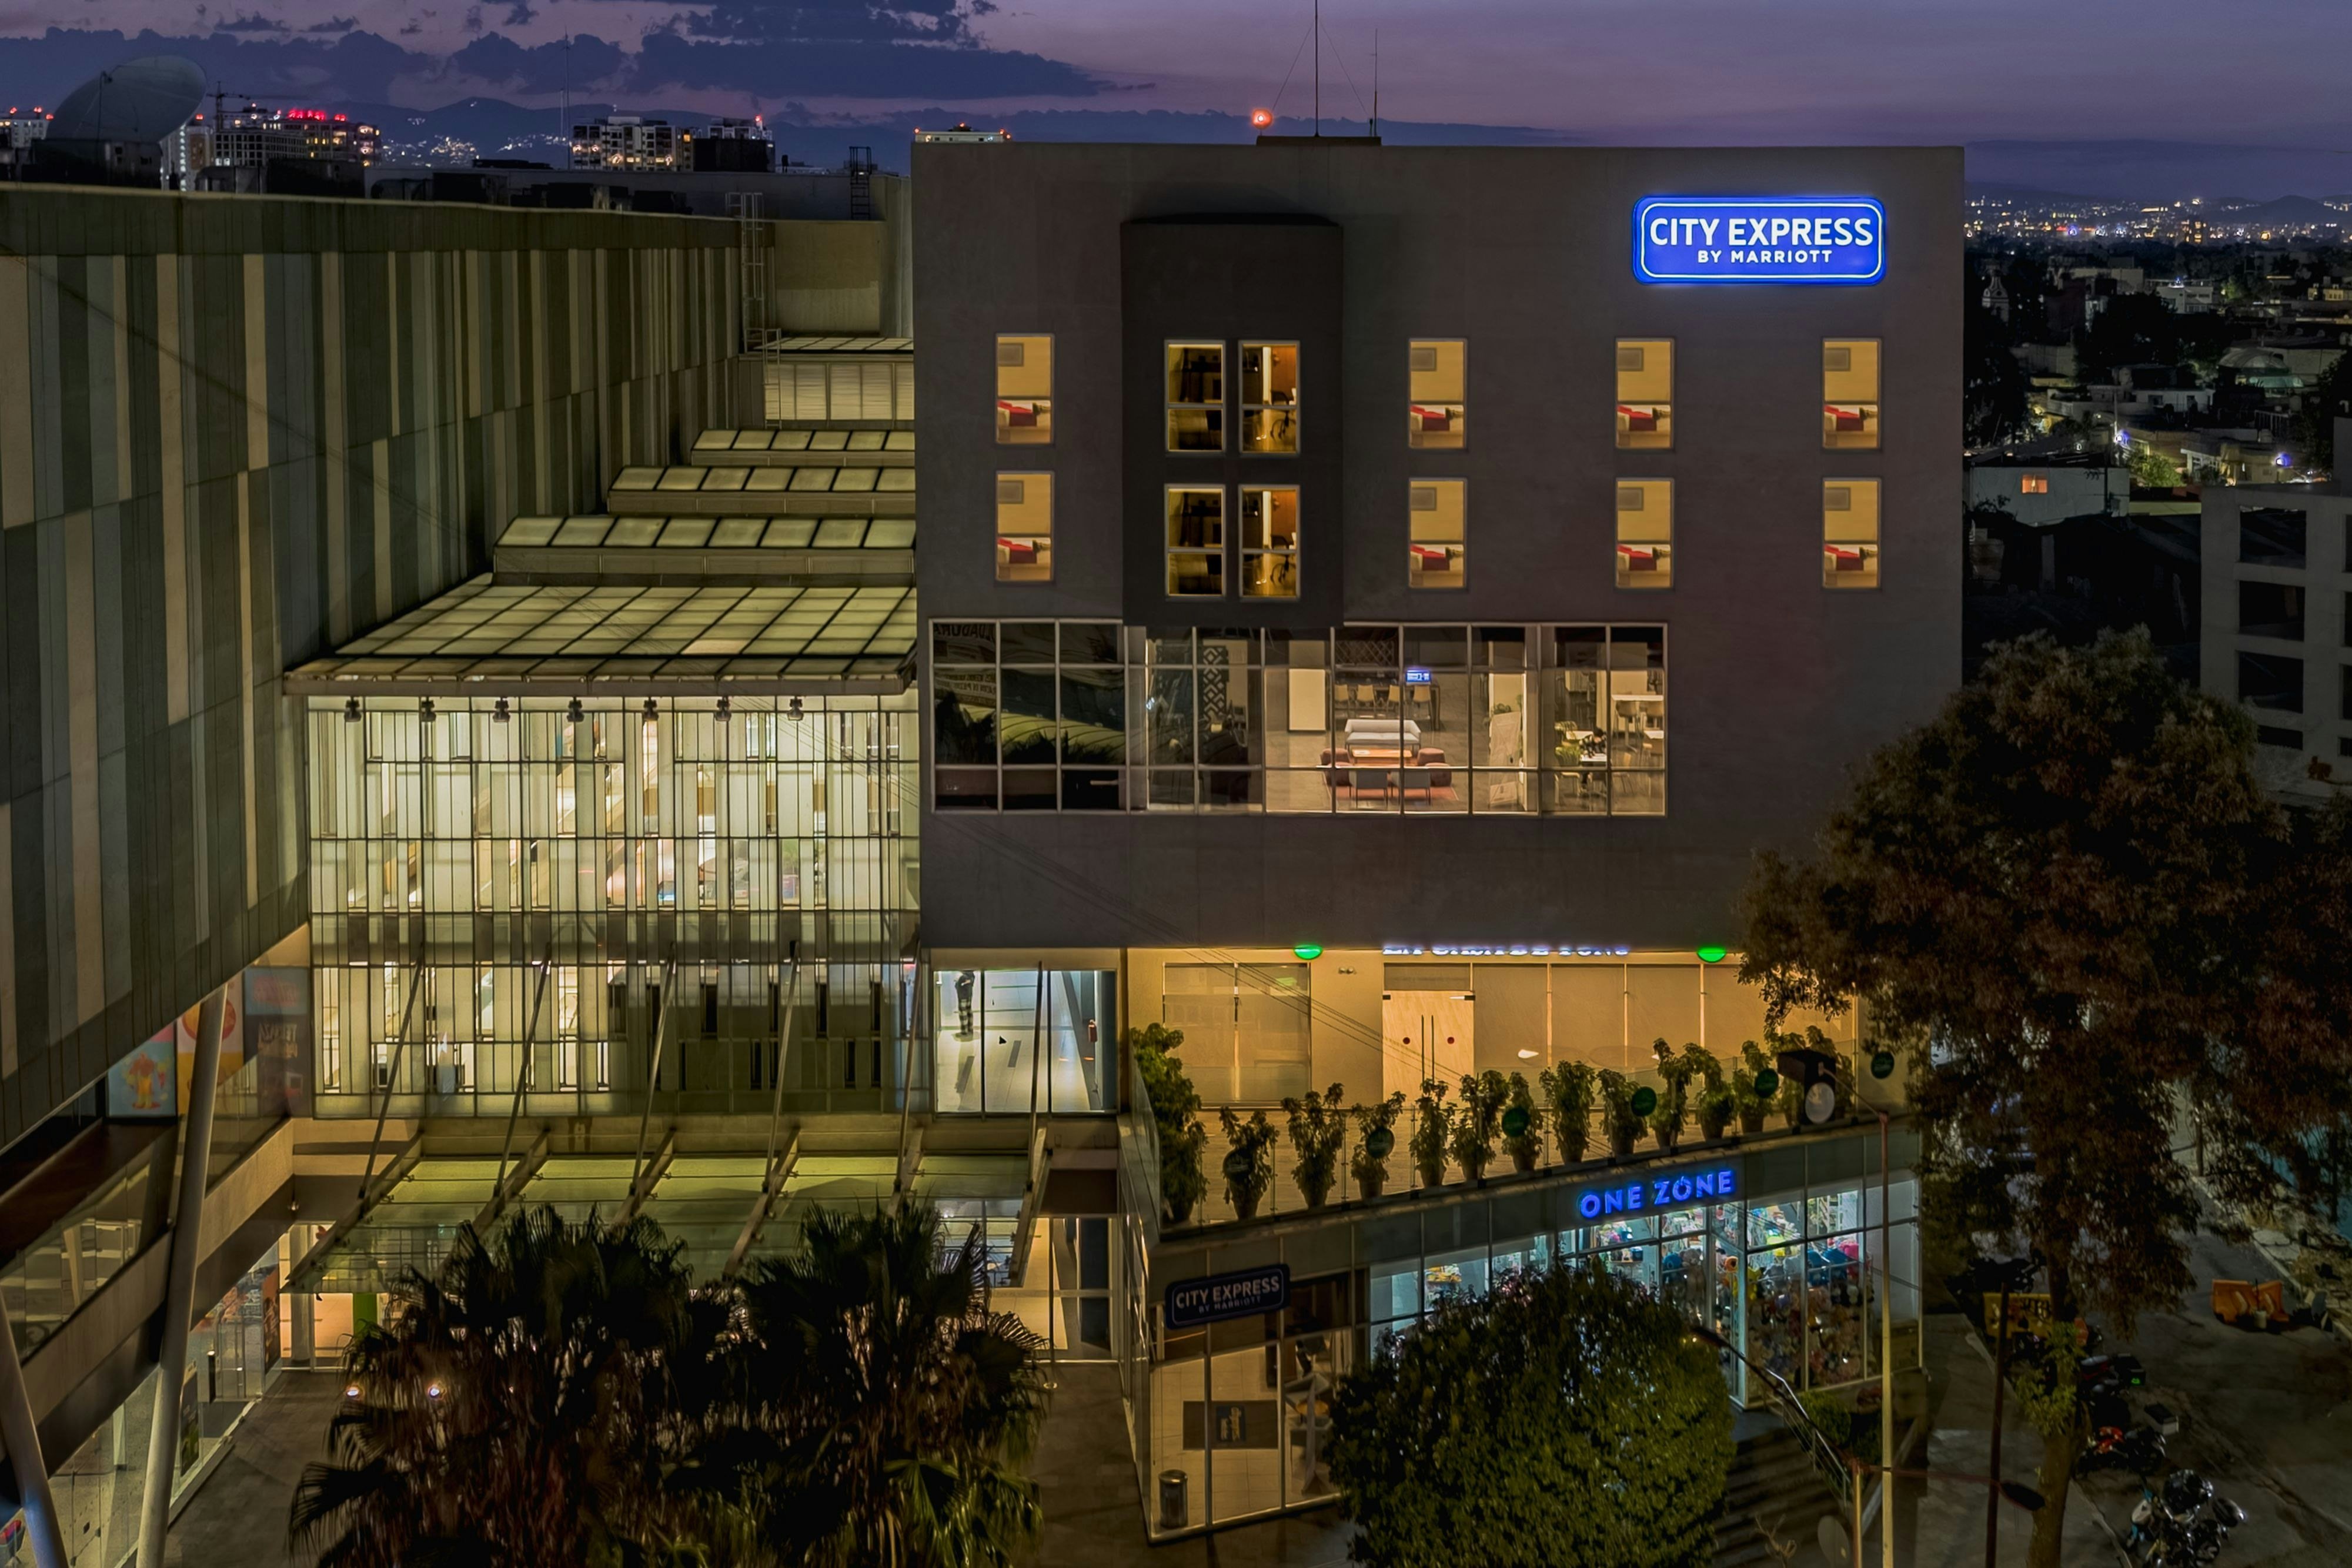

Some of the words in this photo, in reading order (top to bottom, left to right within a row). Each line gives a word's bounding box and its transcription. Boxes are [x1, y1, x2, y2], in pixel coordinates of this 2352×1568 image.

[1650, 218, 1720, 246] CITY
[1729, 218, 1873, 246] EXPRESS
[1698, 250, 1722, 263] BY
[1731, 250, 1833, 263] MARRIOTT
[1580, 1186, 1642, 1219] ONE
[1653, 1170, 1733, 1205] ZONE
[1175, 1288, 1209, 1309] CITY
[1212, 1275, 1280, 1302] EXPRESS
[1198, 1304, 1210, 1314] BY
[1214, 1295, 1261, 1311] MARRIOTT
